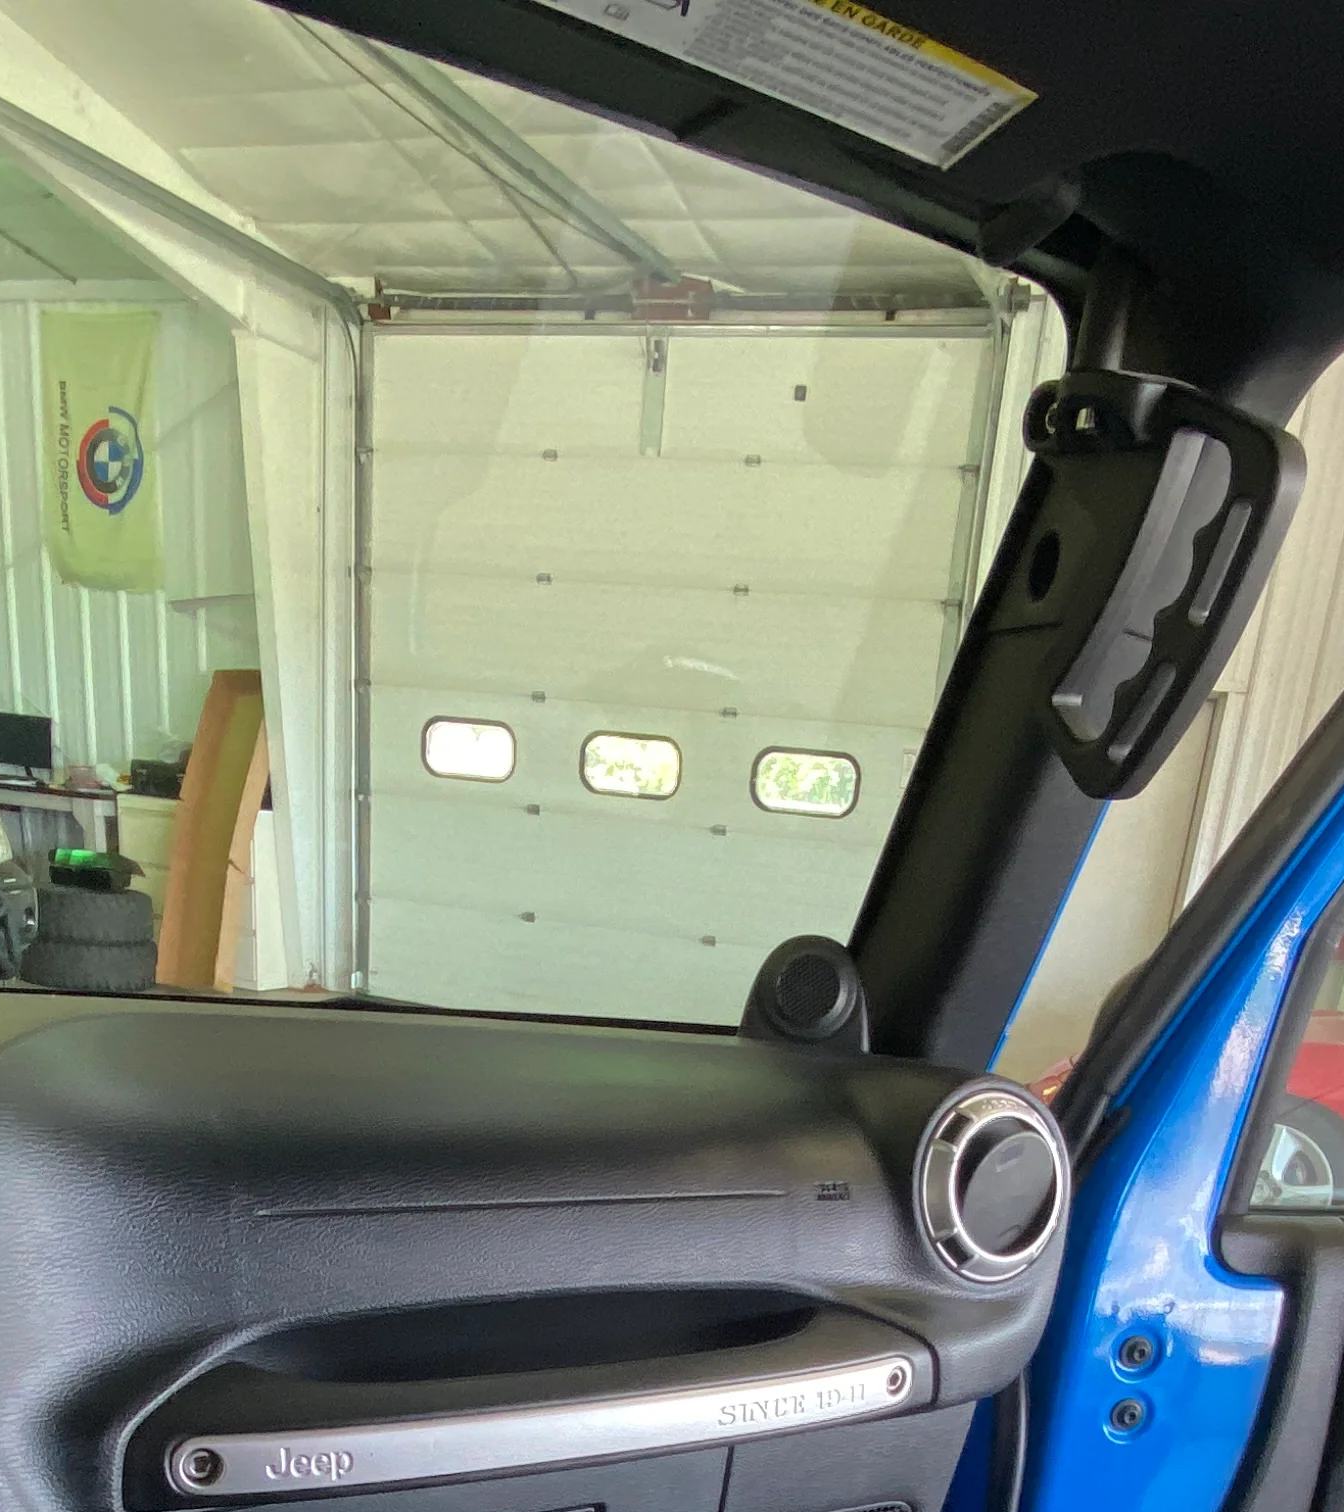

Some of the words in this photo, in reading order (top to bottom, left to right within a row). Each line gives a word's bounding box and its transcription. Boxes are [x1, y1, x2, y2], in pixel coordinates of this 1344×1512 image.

[57, 423, 71, 533] MOTORSPORT
[717, 1393, 806, 1427] SINCE
[265, 1447, 354, 1482] Jeep
